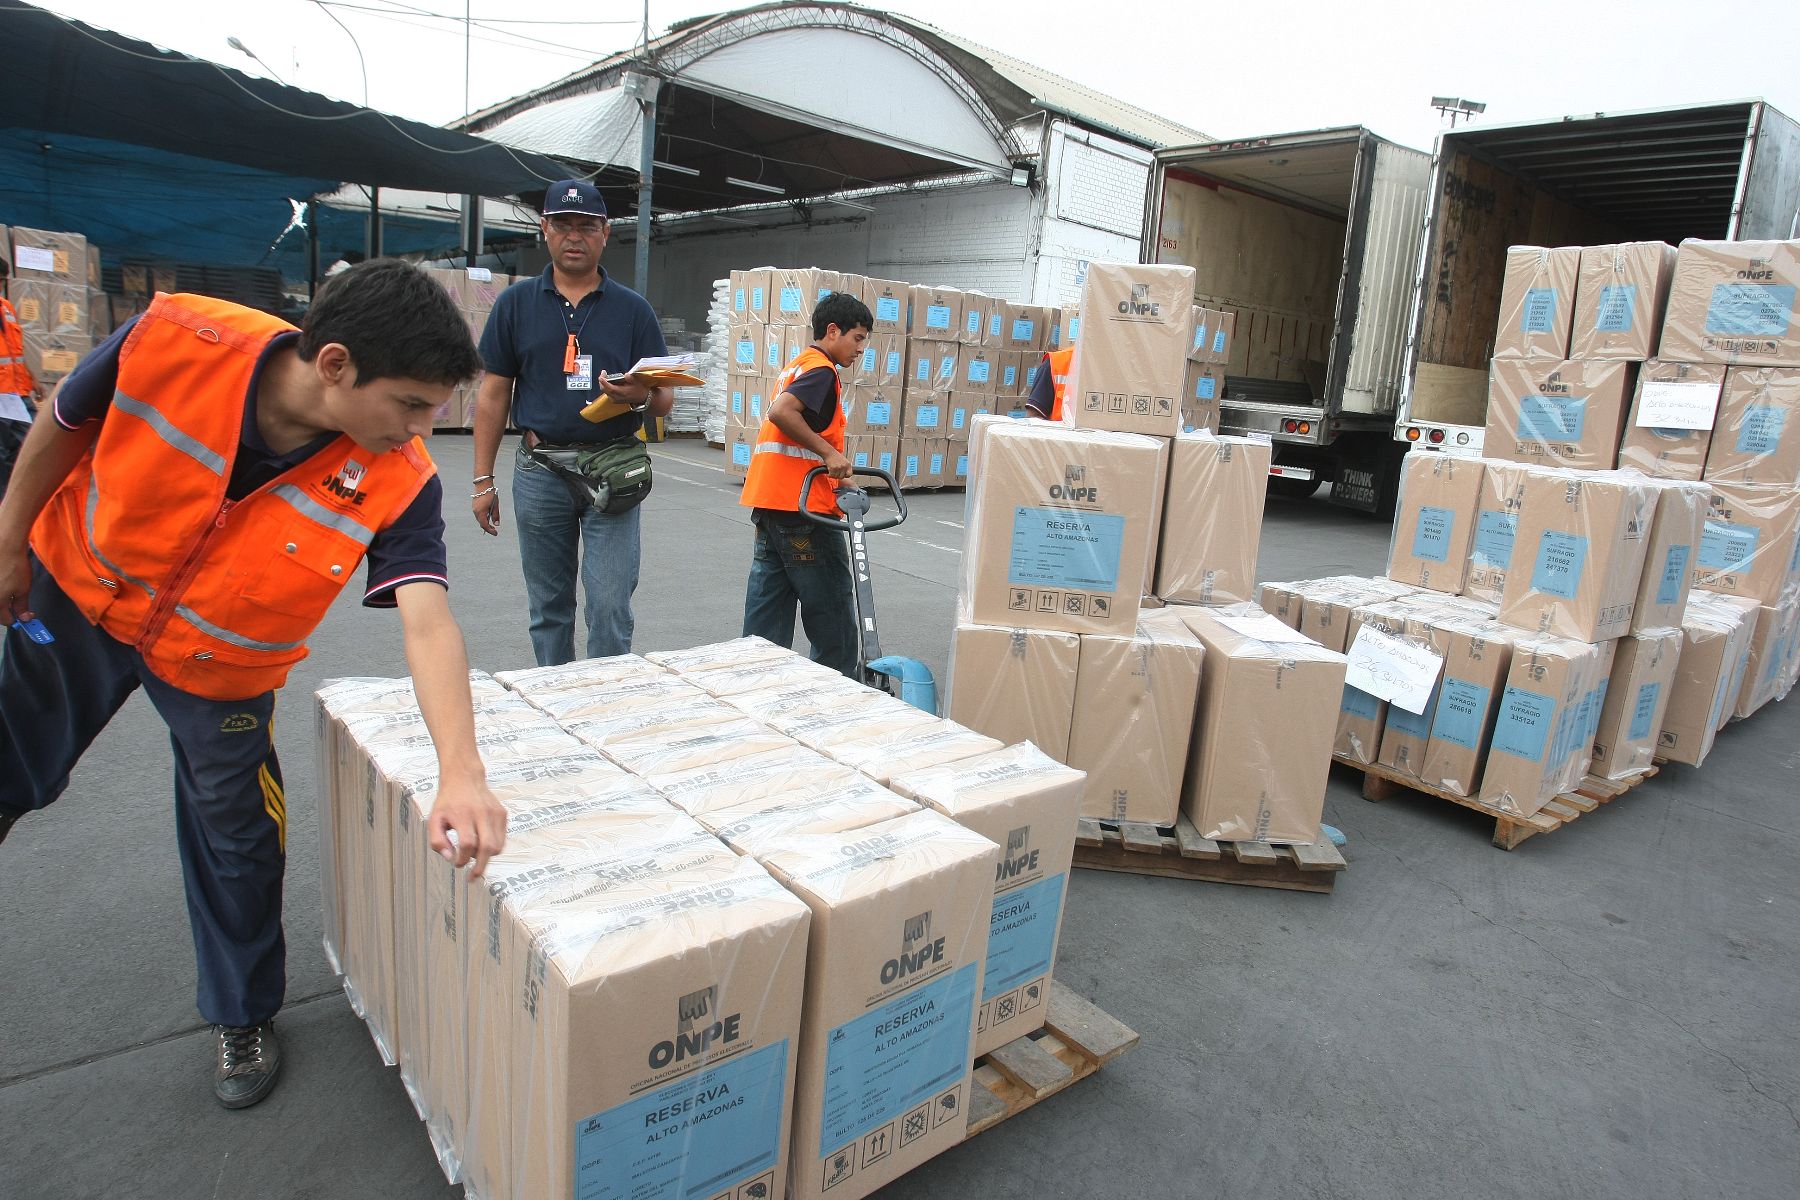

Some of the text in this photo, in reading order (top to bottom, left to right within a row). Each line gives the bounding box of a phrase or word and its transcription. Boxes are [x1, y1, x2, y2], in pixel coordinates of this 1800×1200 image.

[1163, 237, 1178, 249] 2163
[1737, 270, 1774, 280] ONPE
[1117, 301, 1160, 316] ONPE
[1539, 383, 1568, 392] ONPE
[1344, 469, 1374, 487] THINK
[1048, 484, 1098, 503] ONPE
[1336, 483, 1374, 502] FLOWERS
[1046, 520, 1092, 533] RESERVA
[1046, 533, 1099, 544] ALTO AMAZONAS
[1546, 547, 1575, 558] SUFRAGIO
[1448, 695, 1477, 707] SUFRAGIO
[1509, 705, 1541, 718] SUFRAGIO
[1510, 713, 1535, 726] 335124
[977, 763, 1025, 779] ONPE
[662, 771, 719, 792] ONPE
[514, 801, 578, 823] ONPE
[506, 822, 539, 834] ACIONAL
[840, 833, 899, 857] ONPE
[489, 863, 566, 897] ONPE
[662, 887, 736, 916] ONPE
[990, 901, 1031, 925] ESERVA
[1001, 912, 1038, 934] AMAZONAS
[880, 936, 946, 986] ONPE
[874, 1000, 936, 1040] RESERVA
[648, 1013, 741, 1070] ONPE
[874, 1012, 946, 1054] ALTO AMAZONAS
[630, 1077, 654, 1090] OFICINA
[654, 1065, 683, 1081] NACIONAL
[683, 1062, 691, 1071] DE
[645, 1083, 731, 1128] RESERVA
[646, 1096, 745, 1145] ALTO AMAZONAS
